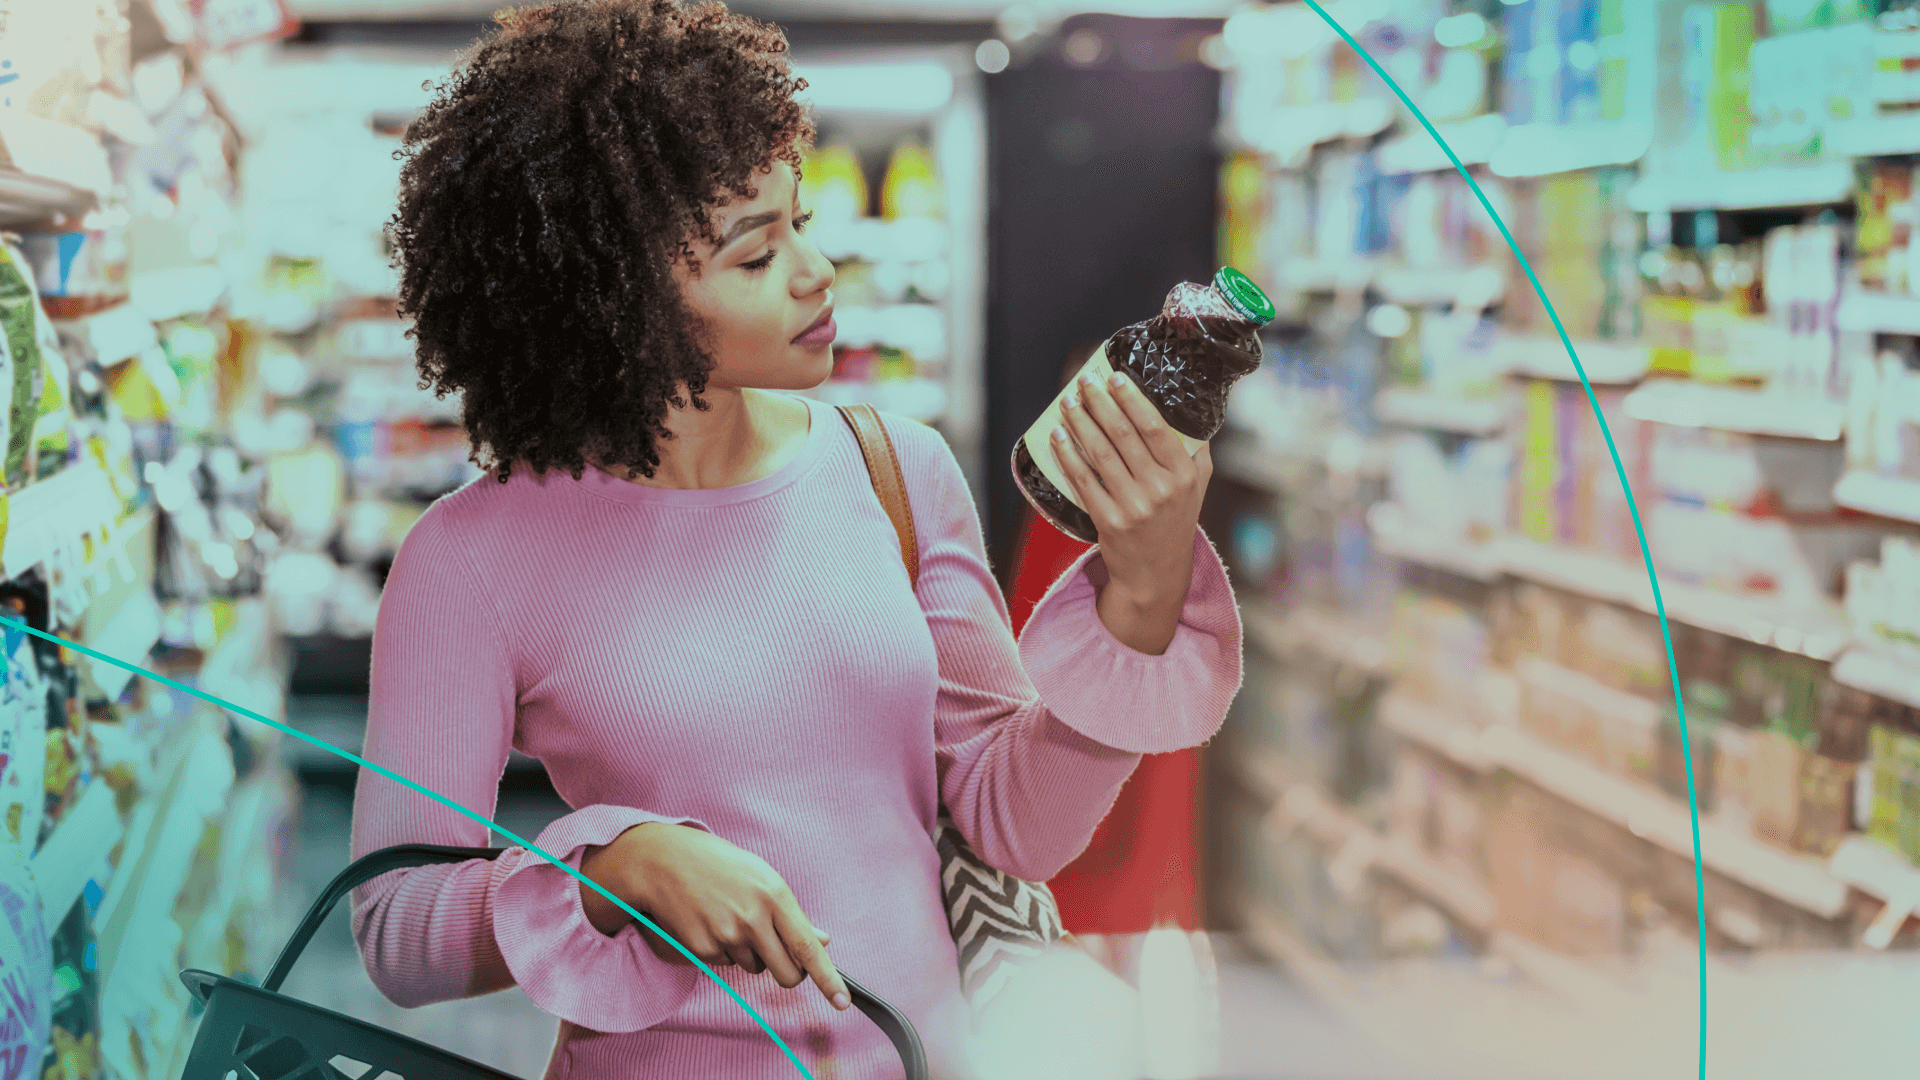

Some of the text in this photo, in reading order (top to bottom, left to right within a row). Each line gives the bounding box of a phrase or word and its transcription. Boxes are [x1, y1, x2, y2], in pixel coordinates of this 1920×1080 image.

[1225, 289, 1235, 301] FOR
[1231, 296, 1244, 309] YOUR
[1240, 306, 1257, 320] SAFETY
